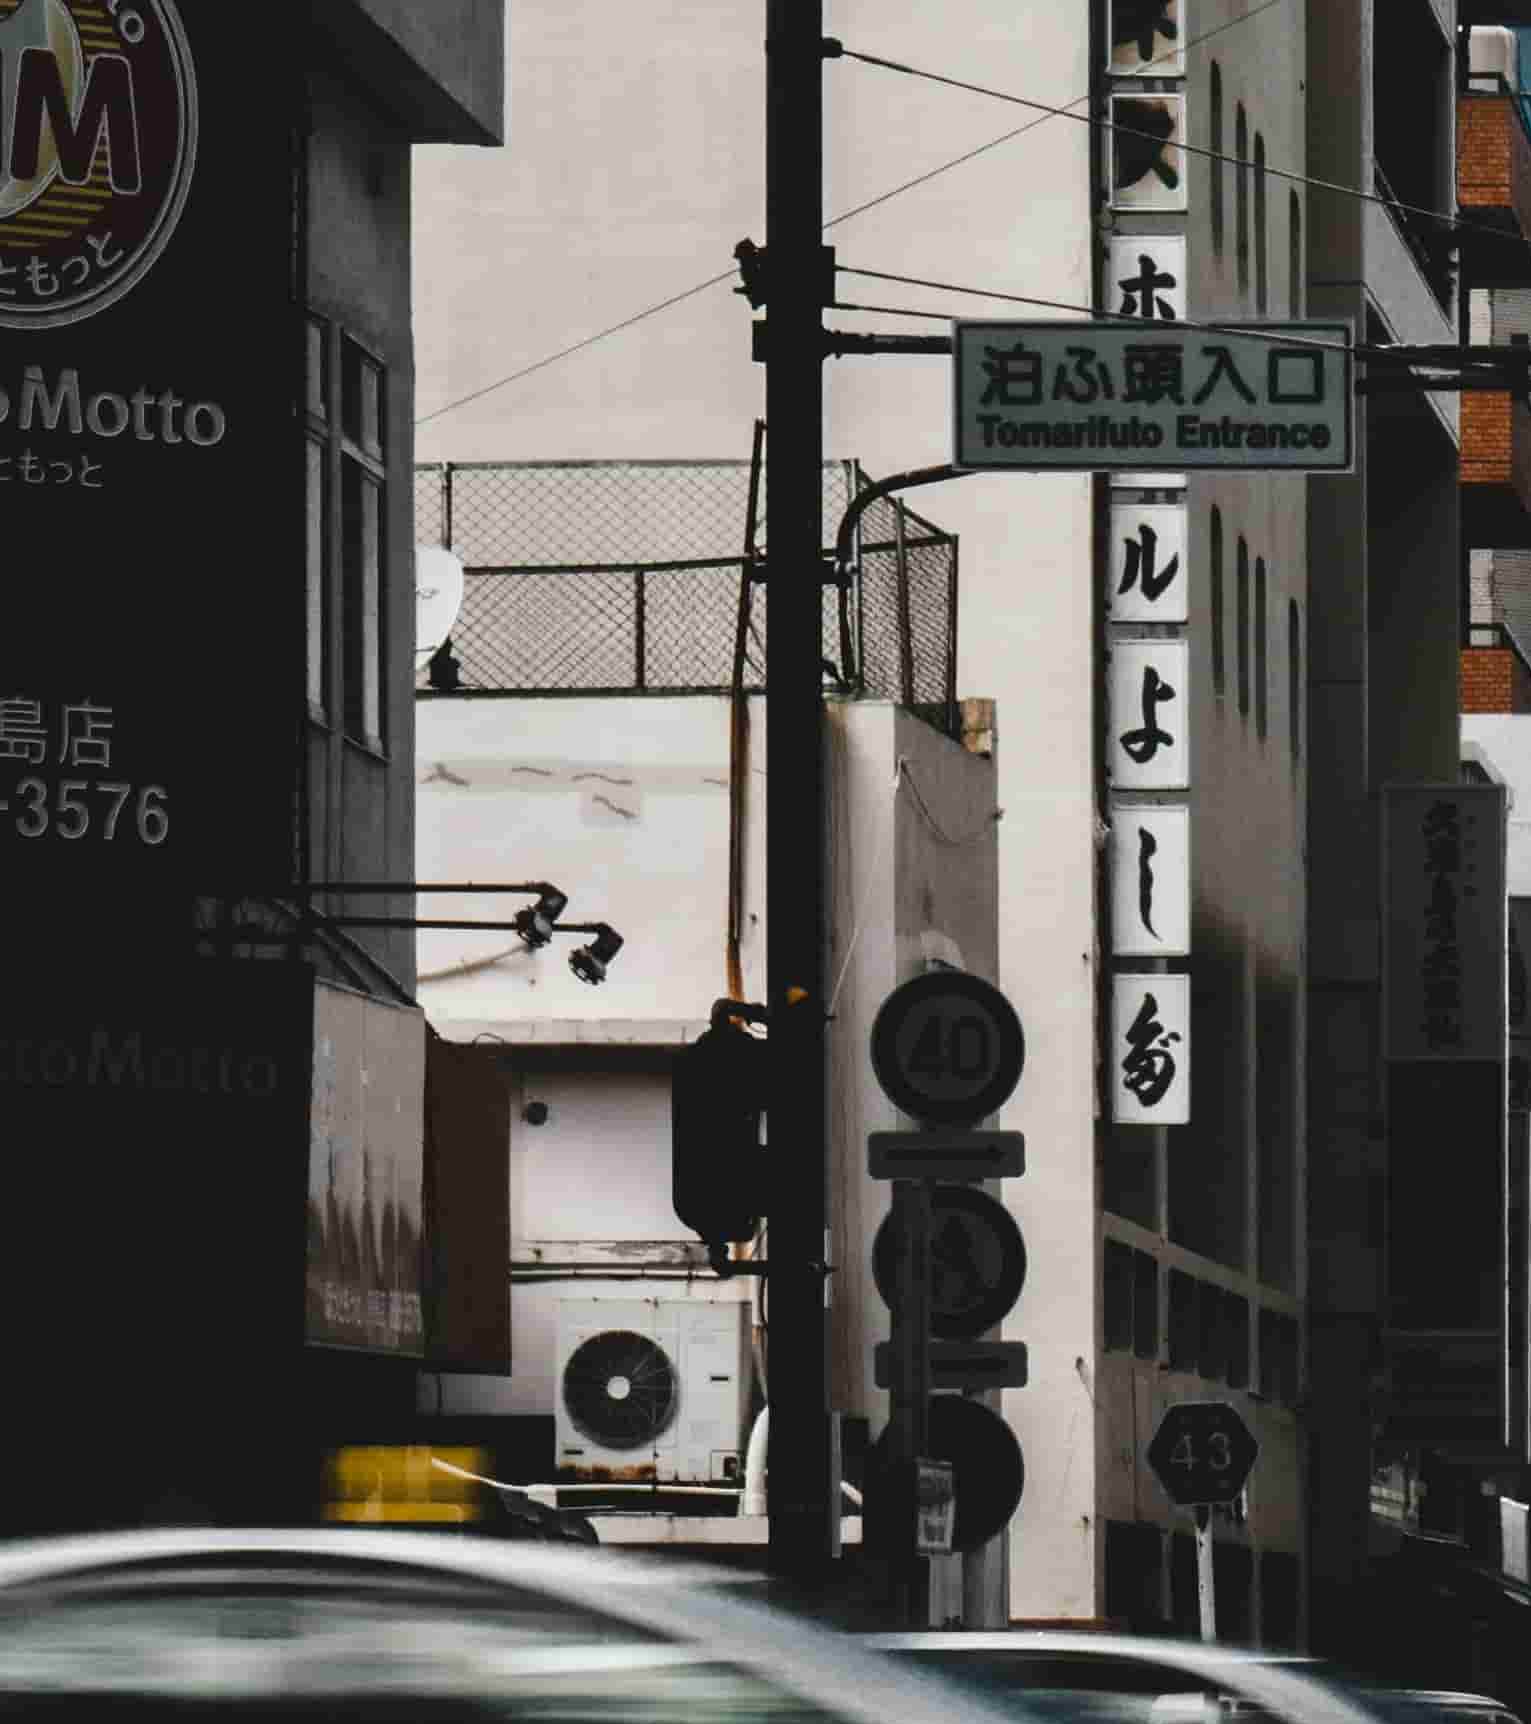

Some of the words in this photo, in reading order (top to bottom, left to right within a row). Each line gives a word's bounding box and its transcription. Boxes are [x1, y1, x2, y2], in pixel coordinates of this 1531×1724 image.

[980, 343, 1325, 405] 泊ふ頭入口
[1176, 415, 1331, 450] Entrance
[908, 1015, 989, 1080] 40
[1167, 1431, 1232, 1472] 43
